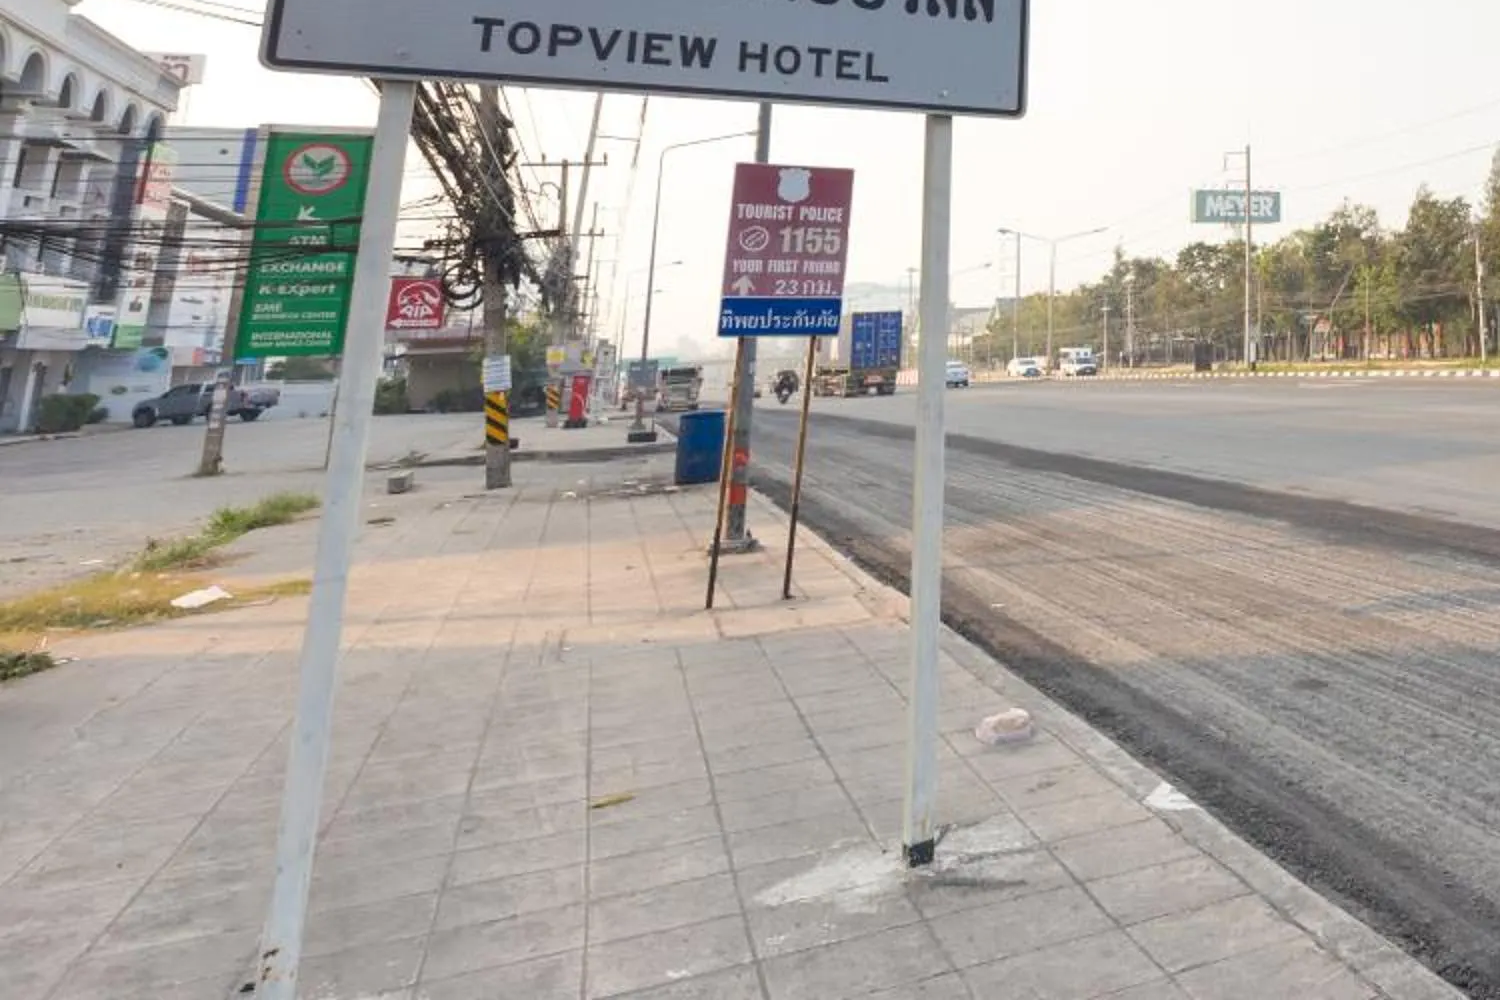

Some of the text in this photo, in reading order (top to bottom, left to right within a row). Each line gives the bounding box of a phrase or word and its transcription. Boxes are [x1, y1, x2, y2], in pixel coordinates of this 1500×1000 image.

[473, 16, 890, 83] TOPVIEW HOTEL
[737, 203, 843, 222] TOURIST POLICE
[779, 226, 841, 255] 1155
[260, 262, 347, 273] EXCHANGE
[733, 259, 763, 273] YOUR
[767, 260, 799, 273] FIRST
[775, 279, 799, 295] 23
